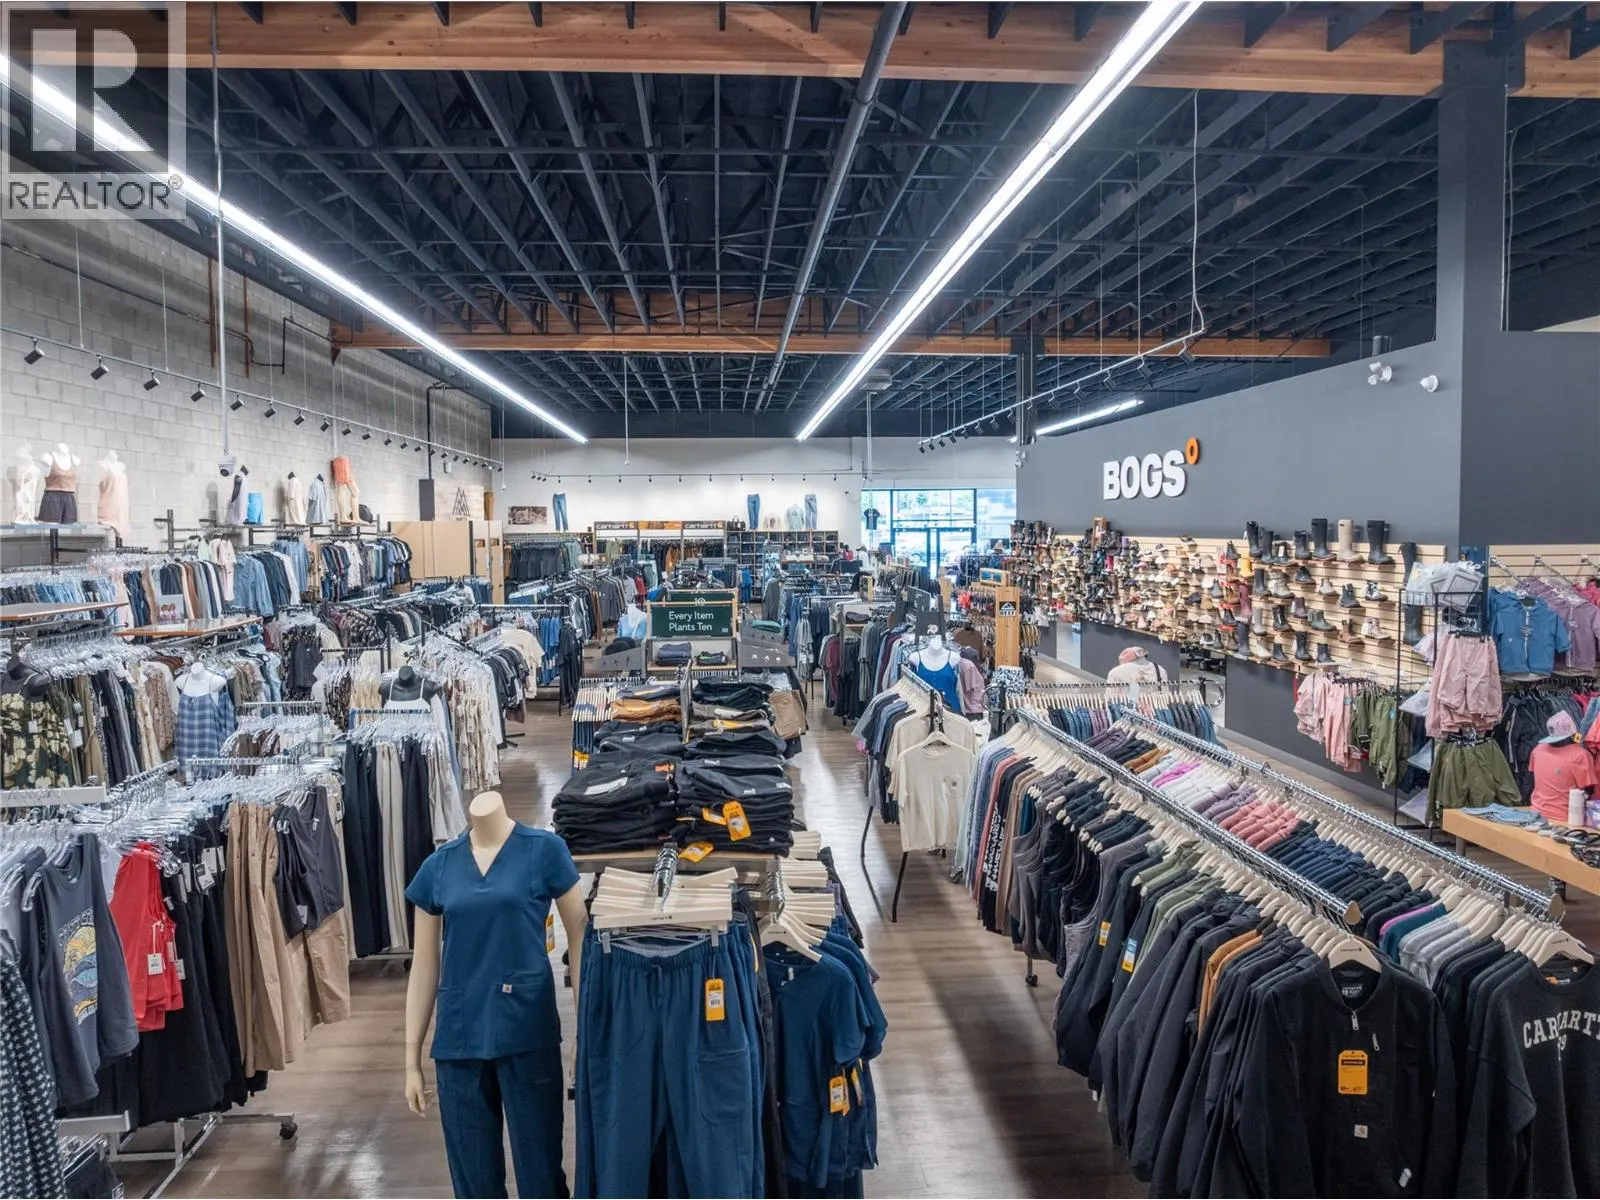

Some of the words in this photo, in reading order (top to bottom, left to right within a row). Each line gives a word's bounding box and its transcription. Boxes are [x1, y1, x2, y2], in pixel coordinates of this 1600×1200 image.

[668, 611, 692, 622] Every
[694, 611, 714, 620] Item
[668, 622, 695, 632] Plants
[697, 622, 713, 631] Ten
[1523, 1010, 1600, 1049] CARART
